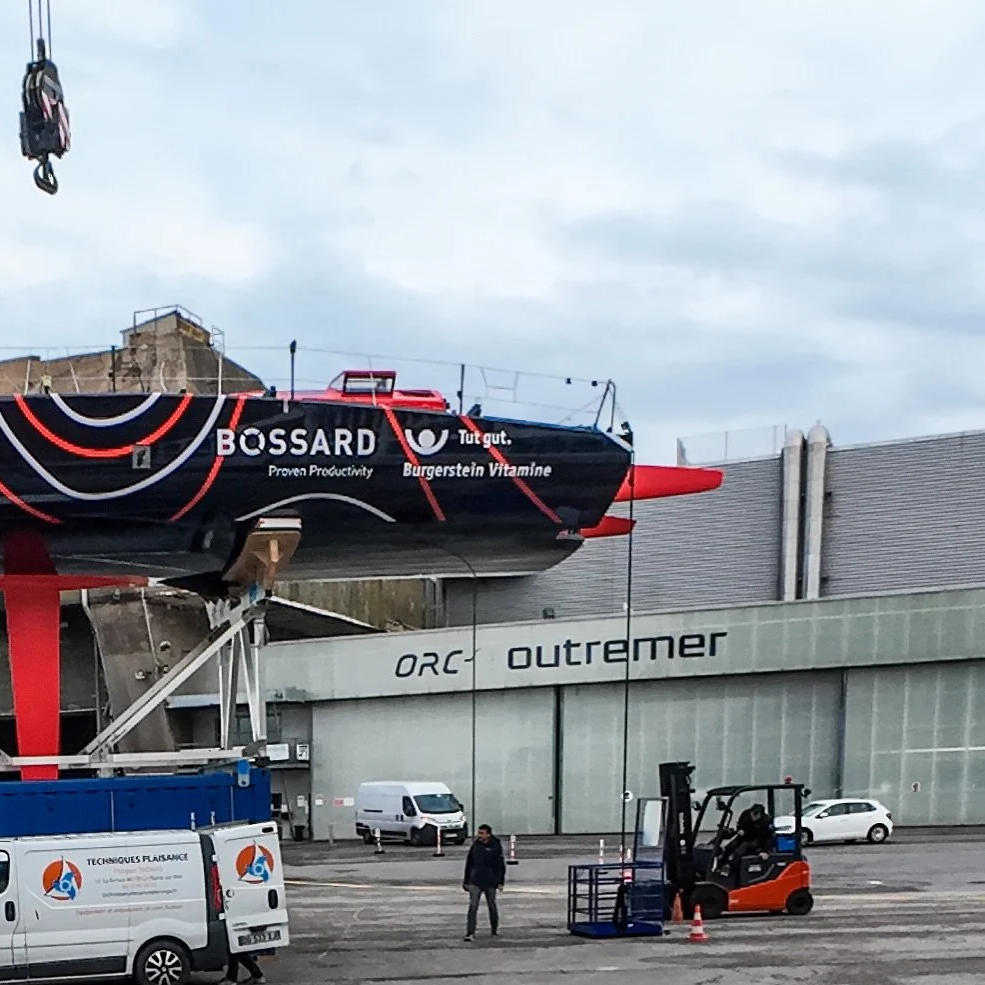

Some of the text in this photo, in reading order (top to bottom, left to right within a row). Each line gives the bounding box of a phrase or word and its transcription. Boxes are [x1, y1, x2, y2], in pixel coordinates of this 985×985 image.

[216, 427, 376, 456] BOSSARD
[458, 429, 512, 448] Tut gut,
[268, 465, 373, 479] Proven Productivity
[402, 461, 552, 480] Burgerstein Vitamine
[507, 631, 728, 670] outremer
[86, 852, 189, 866] TECHNIQUES PLAISANCE
